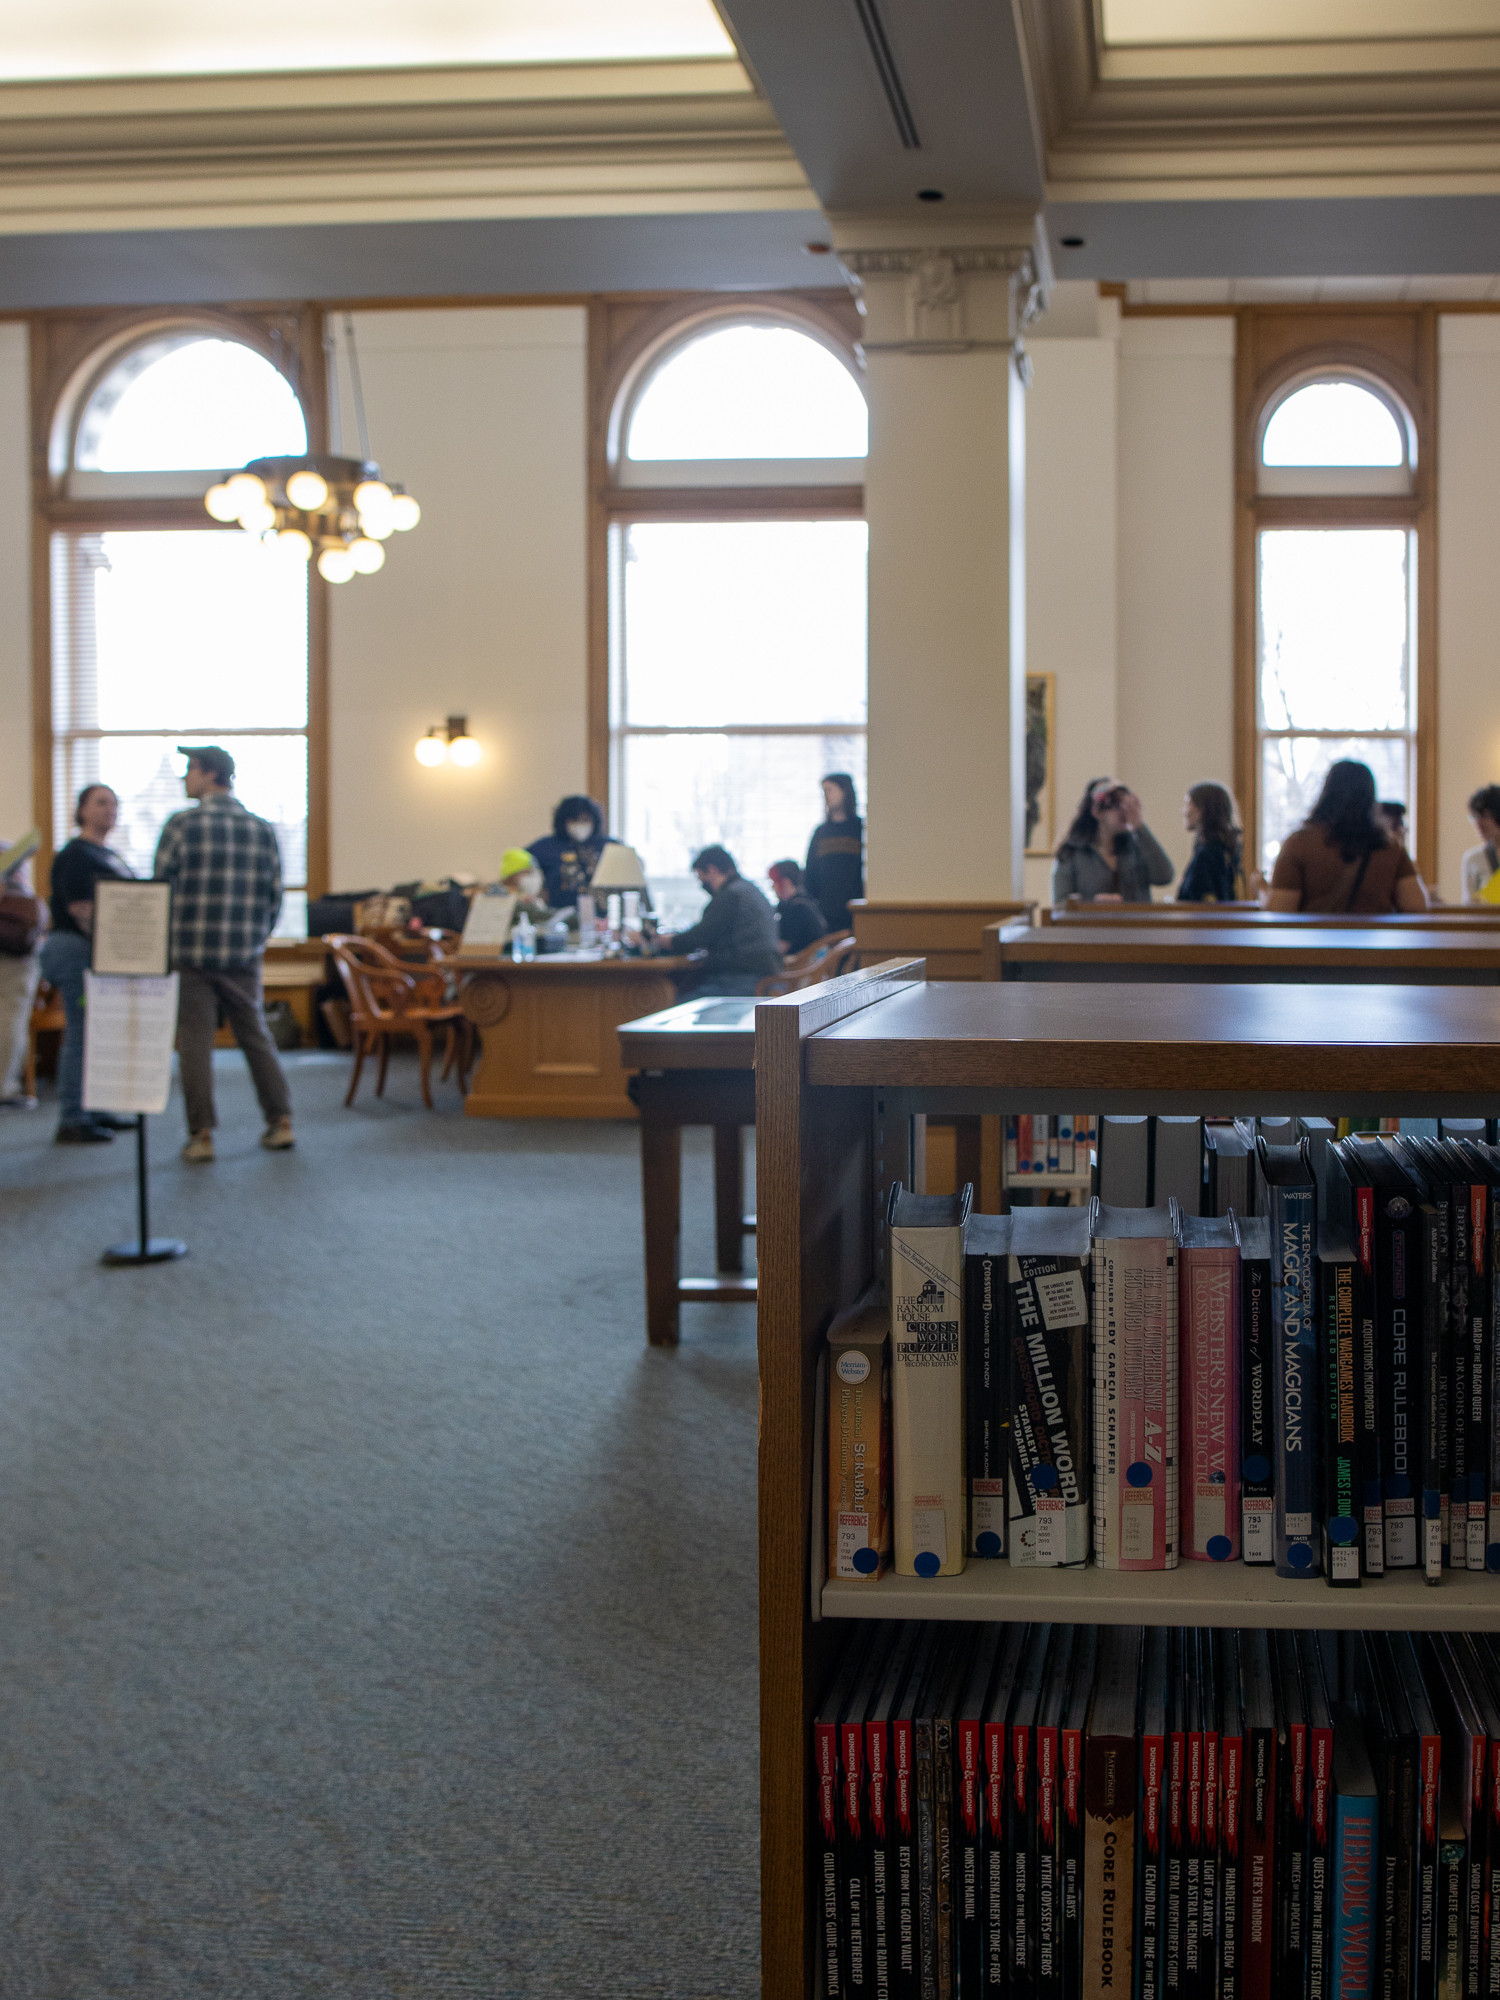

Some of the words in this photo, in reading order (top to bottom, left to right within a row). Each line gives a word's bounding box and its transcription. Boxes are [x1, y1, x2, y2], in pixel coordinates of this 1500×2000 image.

[1282, 1192, 1312, 1200] WATERS
[1302, 1222, 1311, 1242] THE
[1023, 1263, 1057, 1279] EDITION
[1283, 1222, 1300, 1287] MAGIC
[1395, 1232, 1403, 1297] STARFINDER
[1143, 1267, 1162, 1289] THE
[1251, 1268, 1262, 1285] The
[1302, 1243, 1312, 1317] ENCYCLOPEDIA
[1338, 1267, 1352, 1286] THE
[896, 1296, 917, 1305] THE
[897, 1304, 944, 1313] RANDOM
[1015, 1281, 1040, 1328] THE
[1108, 1307, 1114, 1317] BY
[1124, 1268, 1143, 1331] CROSSWORD
[1143, 1294, 1162, 1319] NEW
[1284, 1291, 1300, 1337] AND
[1338, 1287, 1353, 1325] COMPLETE
[897, 1313, 931, 1322] HOUSE
[908, 1322, 958, 1331] CROSS
[1210, 1271, 1231, 1389] WEBSTER'S
[1249, 1289, 1261, 1344] Dictionary
[1303, 1319, 1312, 1332] OF
[1473, 1317, 1483, 1344] HOARD
[898, 1343, 958, 1352] PUZZLE
[918, 1332, 958, 1341] WORD
[1108, 1321, 1116, 1346] EDY
[1362, 1318, 1374, 1371] ACQUISITIONS
[1393, 1309, 1407, 1365] CORE
[840, 1361, 867, 1369] Merriam-
[897, 1353, 958, 1362] DICTIONARY
[983, 1347, 990, 1359] TO
[1124, 1337, 1143, 1400] DICTIONARY
[1143, 1324, 1163, 1413] COMPREHENSIVE
[1339, 1328, 1354, 1390] WARGAMES
[1472, 1352, 1481, 1363] THE
[1026, 1332, 1064, 1426] MILLION
[1108, 1352, 1116, 1401] GARCIA
[1330, 1363, 1338, 1420] EDITION
[1472, 1363, 1483, 1395] DRAGON
[838, 1389, 851, 1424] Players
[855, 1389, 863, 1403] The
[1251, 1363, 1263, 1445] WORDPLAY
[1285, 1341, 1302, 1452] MAGICIANS
[1363, 1371, 1375, 1430] INCORPORATED
[1472, 1396, 1482, 1422] QUEEN
[854, 1405, 863, 1438] Official
[1018, 1404, 1038, 1455] STANLEY
[1210, 1391, 1225, 1445] NEW
[1340, 1392, 1355, 1443] HANDBOOK
[1393, 1371, 1408, 1475] RULEBOO
[1439, 1375, 1448, 1469] DRAGONMARKED
[838, 1428, 850, 1478] Dictionary
[1108, 1408, 1116, 1474] SCHAFFER
[1143, 1416, 1163, 1464] A-Z
[854, 1443, 867, 1512] SCRABBLE
[1050, 1430, 1079, 1504] WORD
[914, 1495, 943, 1506] REFERENCE
[974, 1481, 1001, 1492] REFERENCE
[1124, 1490, 1152, 1502] REFERENCE
[1197, 1485, 1224, 1497] REFERENCE
[840, 1514, 868, 1526] REFERENCE
[1036, 1500, 1064, 1511] REFERENCE
[1243, 1500, 1272, 1511] REFERENCE
[1386, 1501, 1413, 1513] REFERENCE
[848, 1733, 856, 1772] DUNGEONS
[847, 1772, 858, 1782] &
[1104, 1750, 1117, 1807] PATHFINDER
[849, 1782, 857, 1818] DRAGONS
[899, 1846, 911, 1868] KEYS
[964, 1847, 975, 1884] MONSTER
[1016, 1852, 1026, 1893] MONSTERS
[1041, 1855, 1053, 1890] MYTHIC
[1103, 1831, 1117, 1882] CORE
[1187, 1858, 1200, 1884] BOO'S
[1203, 1859, 1215, 1886] LIGHT
[1291, 1851, 1302, 1883] PRINCES
[1312, 1856, 1325, 1890] QUESTS
[1341, 1816, 1372, 1918] HEROIC
[823, 1852, 837, 1920] GUILDMASTERS'
[849, 1878, 861, 1900] CALL
[899, 1869, 910, 1891] FROM
[989, 1850, 1001, 1928] MORDENKAINEN'S
[1168, 1858, 1180, 1892] ASTRAL
[1252, 1855, 1264, 1895] PLAYER'S
[1292, 1884, 1300, 1892] OF
[1423, 1864, 1434, 1893] STORM
[1471, 1863, 1481, 1890] SWORD
[850, 1901, 860, 1911] OF
[900, 1892, 911, 1907] THE
[964, 1885, 976, 1920] MANUAL
[1016, 1894, 1024, 1903] OF
[1187, 1885, 1199, 1919] ASTRAL
[1203, 1887, 1213, 1897] OF
[1224, 1867, 1236, 1922] PHANDELVER
[1292, 1892, 1300, 1902] THE
[1313, 1890, 1323, 1913] FROM
[1422, 1894, 1433, 1922] KING'S
[1470, 1890, 1480, 1914] COAST
[851, 1912, 861, 1929] THE
[900, 1908, 912, 1943] GOLDEN
[1016, 1903, 1025, 1917] THE
[1041, 1890, 1053, 1933] ODYSSEYS
[1168, 1893, 1180, 1960] ADVENTURER'S
[1201, 1898, 1215, 1938] XARYXIS
[1251, 1896, 1263, 1943] HANDBOOK
[1290, 1902, 1301, 1950] APOCALYPSE
[1312, 1914, 1323, 1930] THE
[1398, 1890, 1409, 1938] DRAGON
[825, 1922, 838, 1949] GUIDE
[989, 1929, 1001, 1953] TOME
[1016, 1918, 1026, 1967] MULTIVERSE
[1042, 1933, 1051, 1942] OF
[1101, 1889, 1116, 1989] RULEBOOK
[1186, 1919, 1198, 1970] MENAGERIE
[1225, 1923, 1235, 1939] AND
[1420, 1922, 1432, 1963] THUNDER
[1469, 1914, 1480, 1970] ADVENTURER'S
[828, 1950, 836, 1958] TO
[851, 1929, 863, 1985] NETHERDEEP
[901, 1943, 913, 1972] VAULT
[991, 1954, 999, 1962] OF
[1041, 1942, 1053, 1976] THEROS
[1223, 1940, 1235, 1969] BELOW
[1311, 1930, 1323, 1970] INFINITE
[1340, 1920, 1370, 2000] WORL
[1398, 1944, 1409, 1983] MAGIC
[826, 1958, 840, 1997] RAVNICA
[989, 1963, 1001, 1984] FOES
[1167, 1960, 1179, 1988] GUIDE
[1223, 1976, 1235, 1993] THE
[1468, 1971, 1479, 1996] GUIDE
